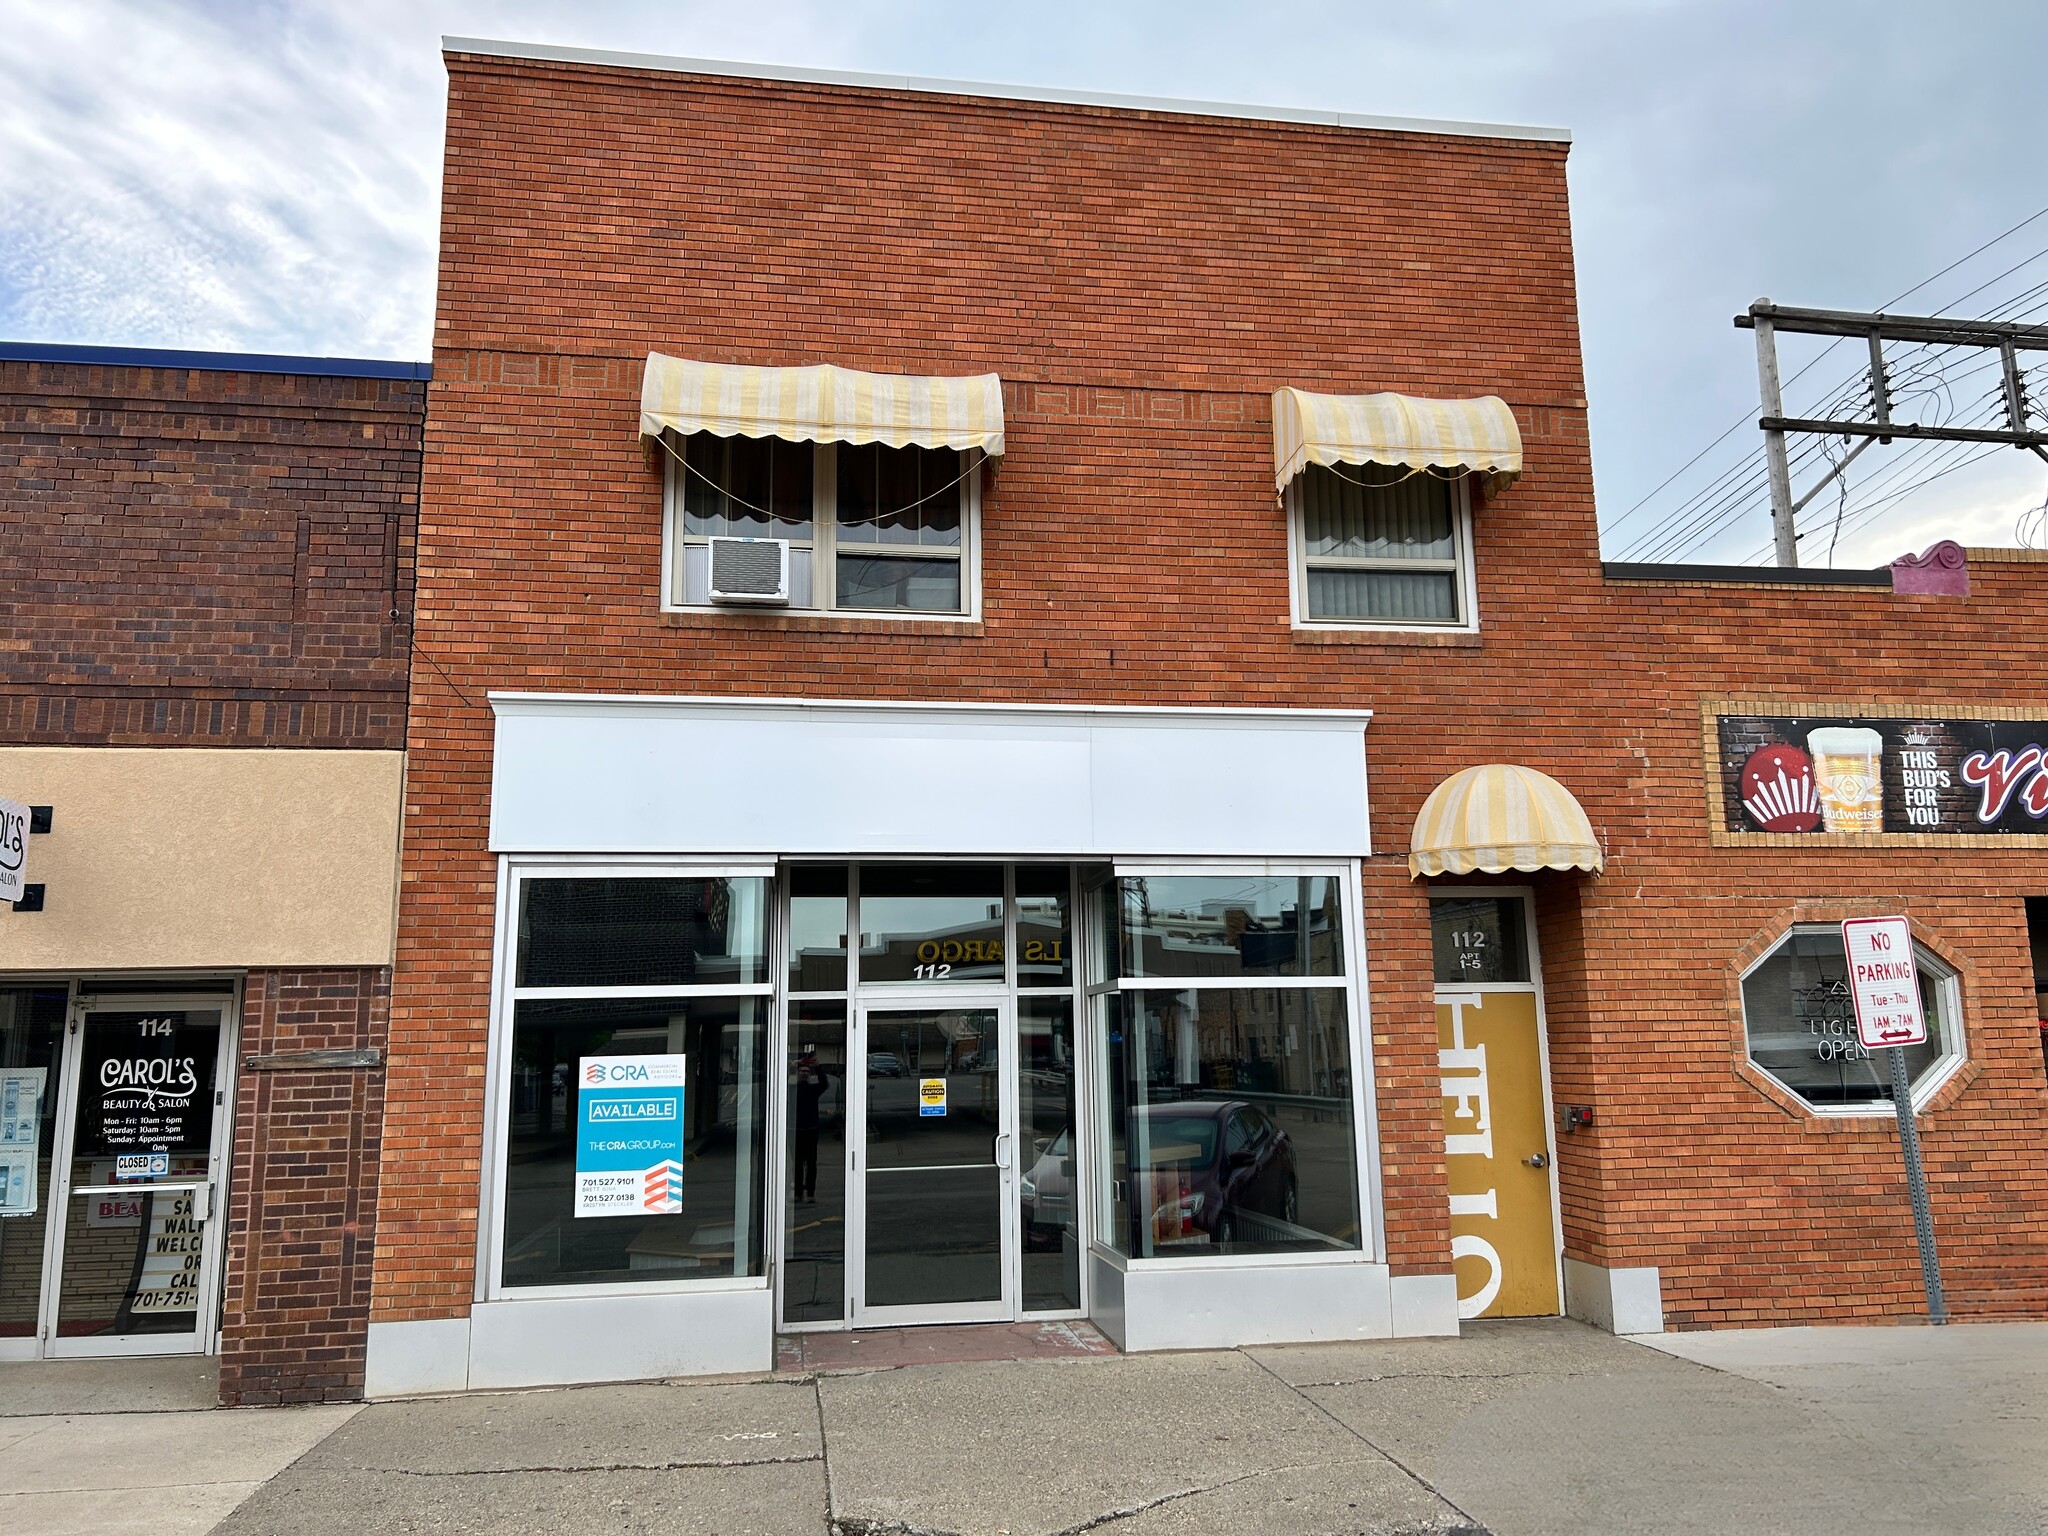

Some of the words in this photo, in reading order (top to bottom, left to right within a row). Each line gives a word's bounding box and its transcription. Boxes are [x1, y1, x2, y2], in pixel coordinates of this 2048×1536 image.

[1899, 751, 1938, 769] THIS
[1902, 769, 1951, 788] BUD'S
[1904, 788, 1938, 806] FOR
[1821, 804, 1883, 820] Budweiser
[1905, 807, 1940, 826] YOU
[1451, 931, 1485, 948] 112
[1870, 932, 1891, 951] NO
[1459, 952, 1480, 960] APT
[913, 964, 951, 979] 112
[1459, 959, 1482, 969] 1-5
[1857, 961, 1910, 982] PARKING
[1870, 994, 1888, 1006] Tue
[1894, 992, 1909, 1004] Thu
[138, 1018, 173, 1036] 114
[1811, 1020, 1857, 1035] LIGH
[1873, 1016, 1891, 1029] 1AM
[1897, 1014, 1914, 1026] 7AM
[1818, 1040, 1870, 1060] OPEN
[100, 1057, 197, 1088] CAROL'S
[611, 1064, 649, 1081] CRA
[103, 1099, 142, 1109] BEAUTY
[158, 1098, 190, 1108] SALON
[592, 1103, 673, 1118] AVAILABLE
[140, 1116, 160, 1124] 10am
[165, 1116, 182, 1124] 6pm
[102, 1126, 137, 1135] Saturday:
[139, 1125, 159, 1133] 10am
[164, 1125, 181, 1134] 5pm
[107, 1135, 136, 1144] Sunday:
[138, 1134, 185, 1143] Appointment
[152, 1143, 169, 1152] Only
[118, 1156, 149, 1169] CLOSED
[583, 1178, 634, 1186] 701.527.9101
[584, 1194, 635, 1202] 701.527.0138
[99, 1202, 143, 1217] BEA
[156, 1236, 203, 1253] WELC
[134, 1291, 199, 1307] 701-751-
